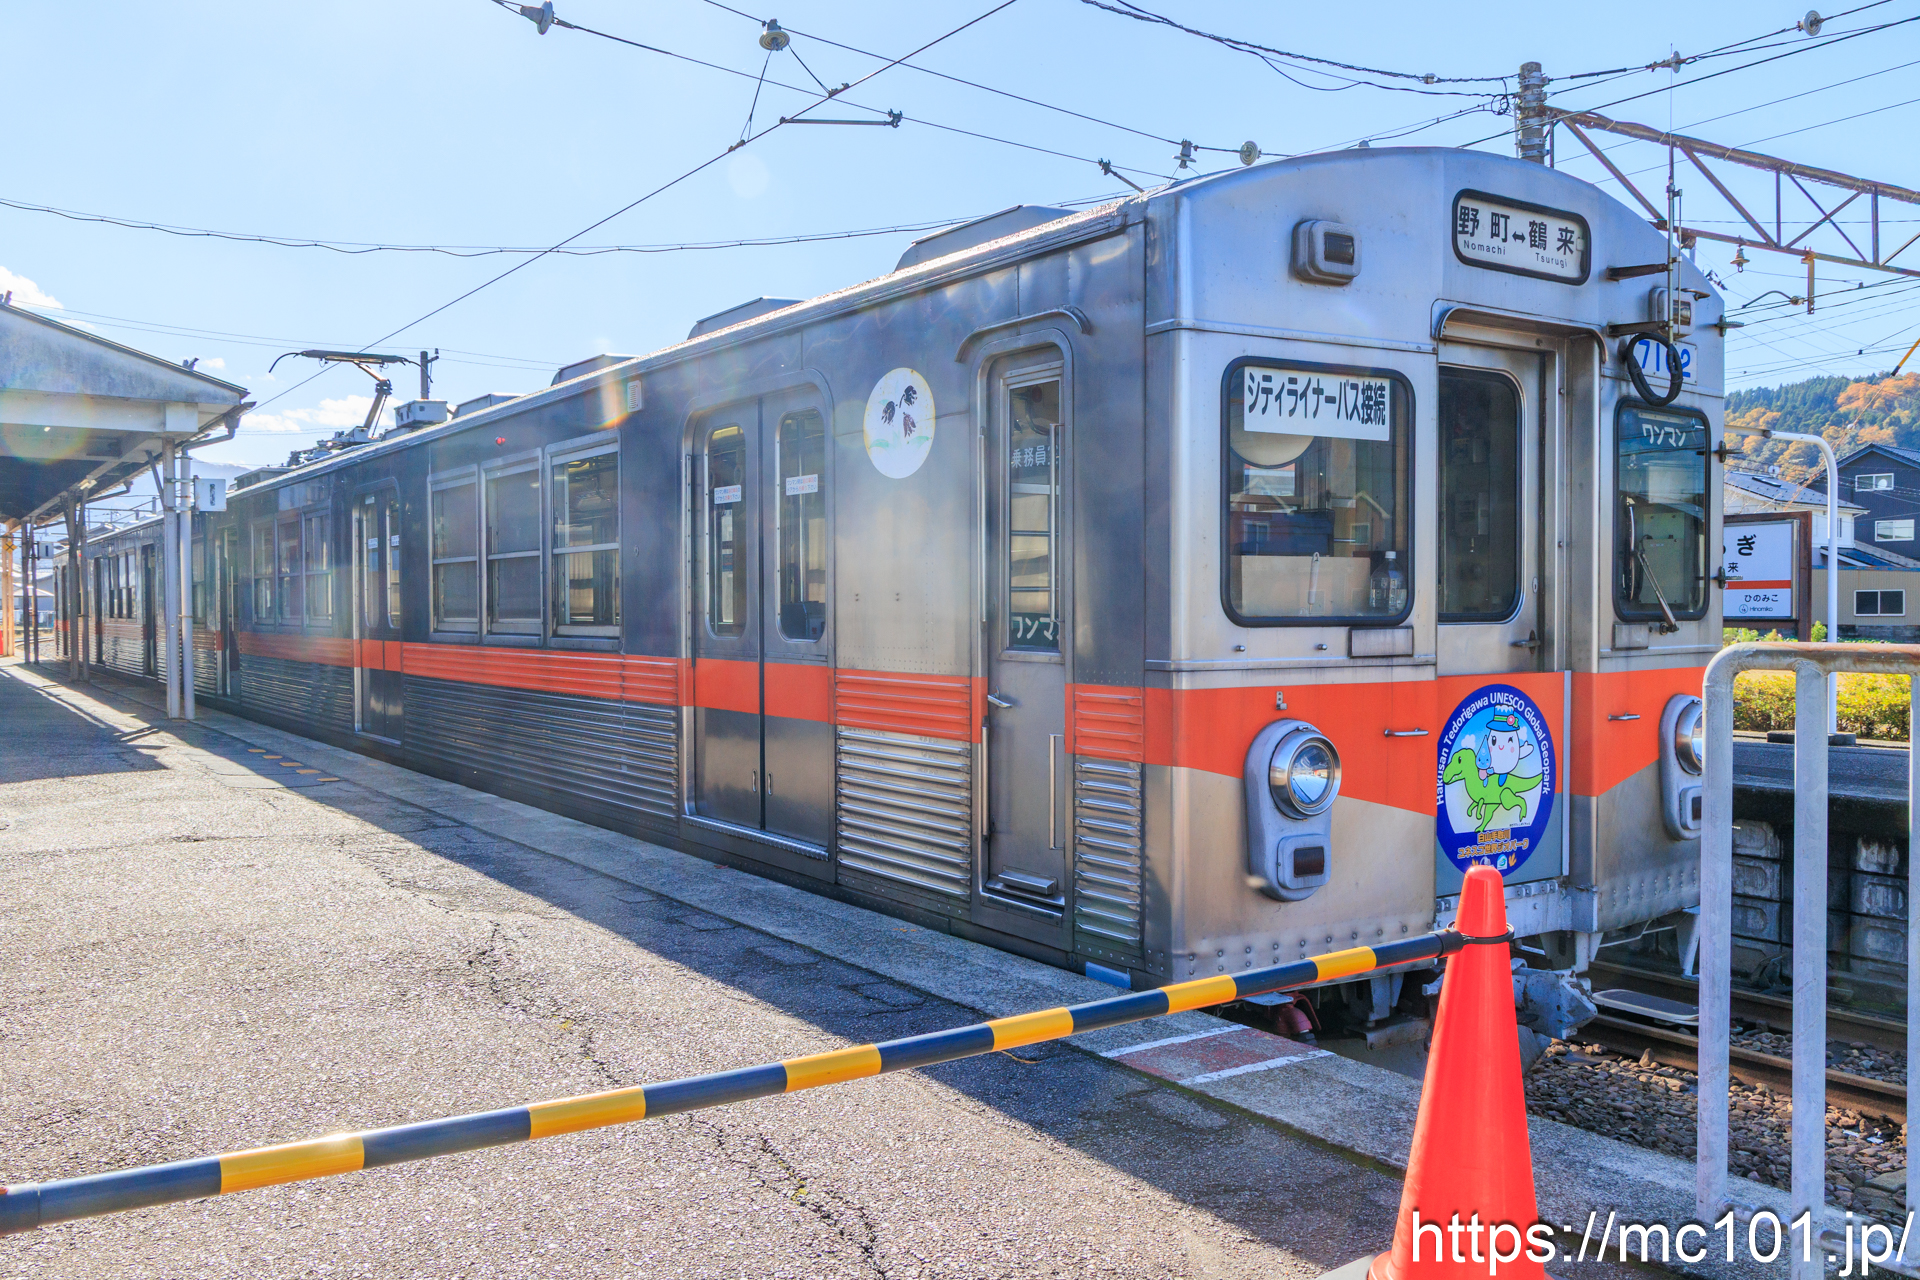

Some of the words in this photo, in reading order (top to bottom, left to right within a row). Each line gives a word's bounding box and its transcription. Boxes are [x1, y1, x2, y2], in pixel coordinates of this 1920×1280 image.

[1458, 205, 1510, 243] 野町
[1528, 220, 1575, 255] 鶴来
[1463, 240, 1506, 255] Nomachi
[1535, 252, 1568, 268] Tsurugi
[1638, 339, 1691, 378] 712
[1247, 372, 1386, 426] シティライナーバス接続
[1642, 423, 1686, 447] ワンマン
[1744, 594, 1779, 602] ひのみこ
[1011, 616, 1059, 640] ワンマ
[1436, 748, 1449, 806] Hakusan
[1443, 696, 1489, 745] Tedorigawa
[1490, 692, 1525, 712] UNESCO
[1524, 707, 1546, 742] Global
[1540, 741, 1551, 795] Geopark
[1457, 838, 1529, 859] ユネスコ世界ジオパーク
[1477, 828, 1512, 844] 白山手取川
